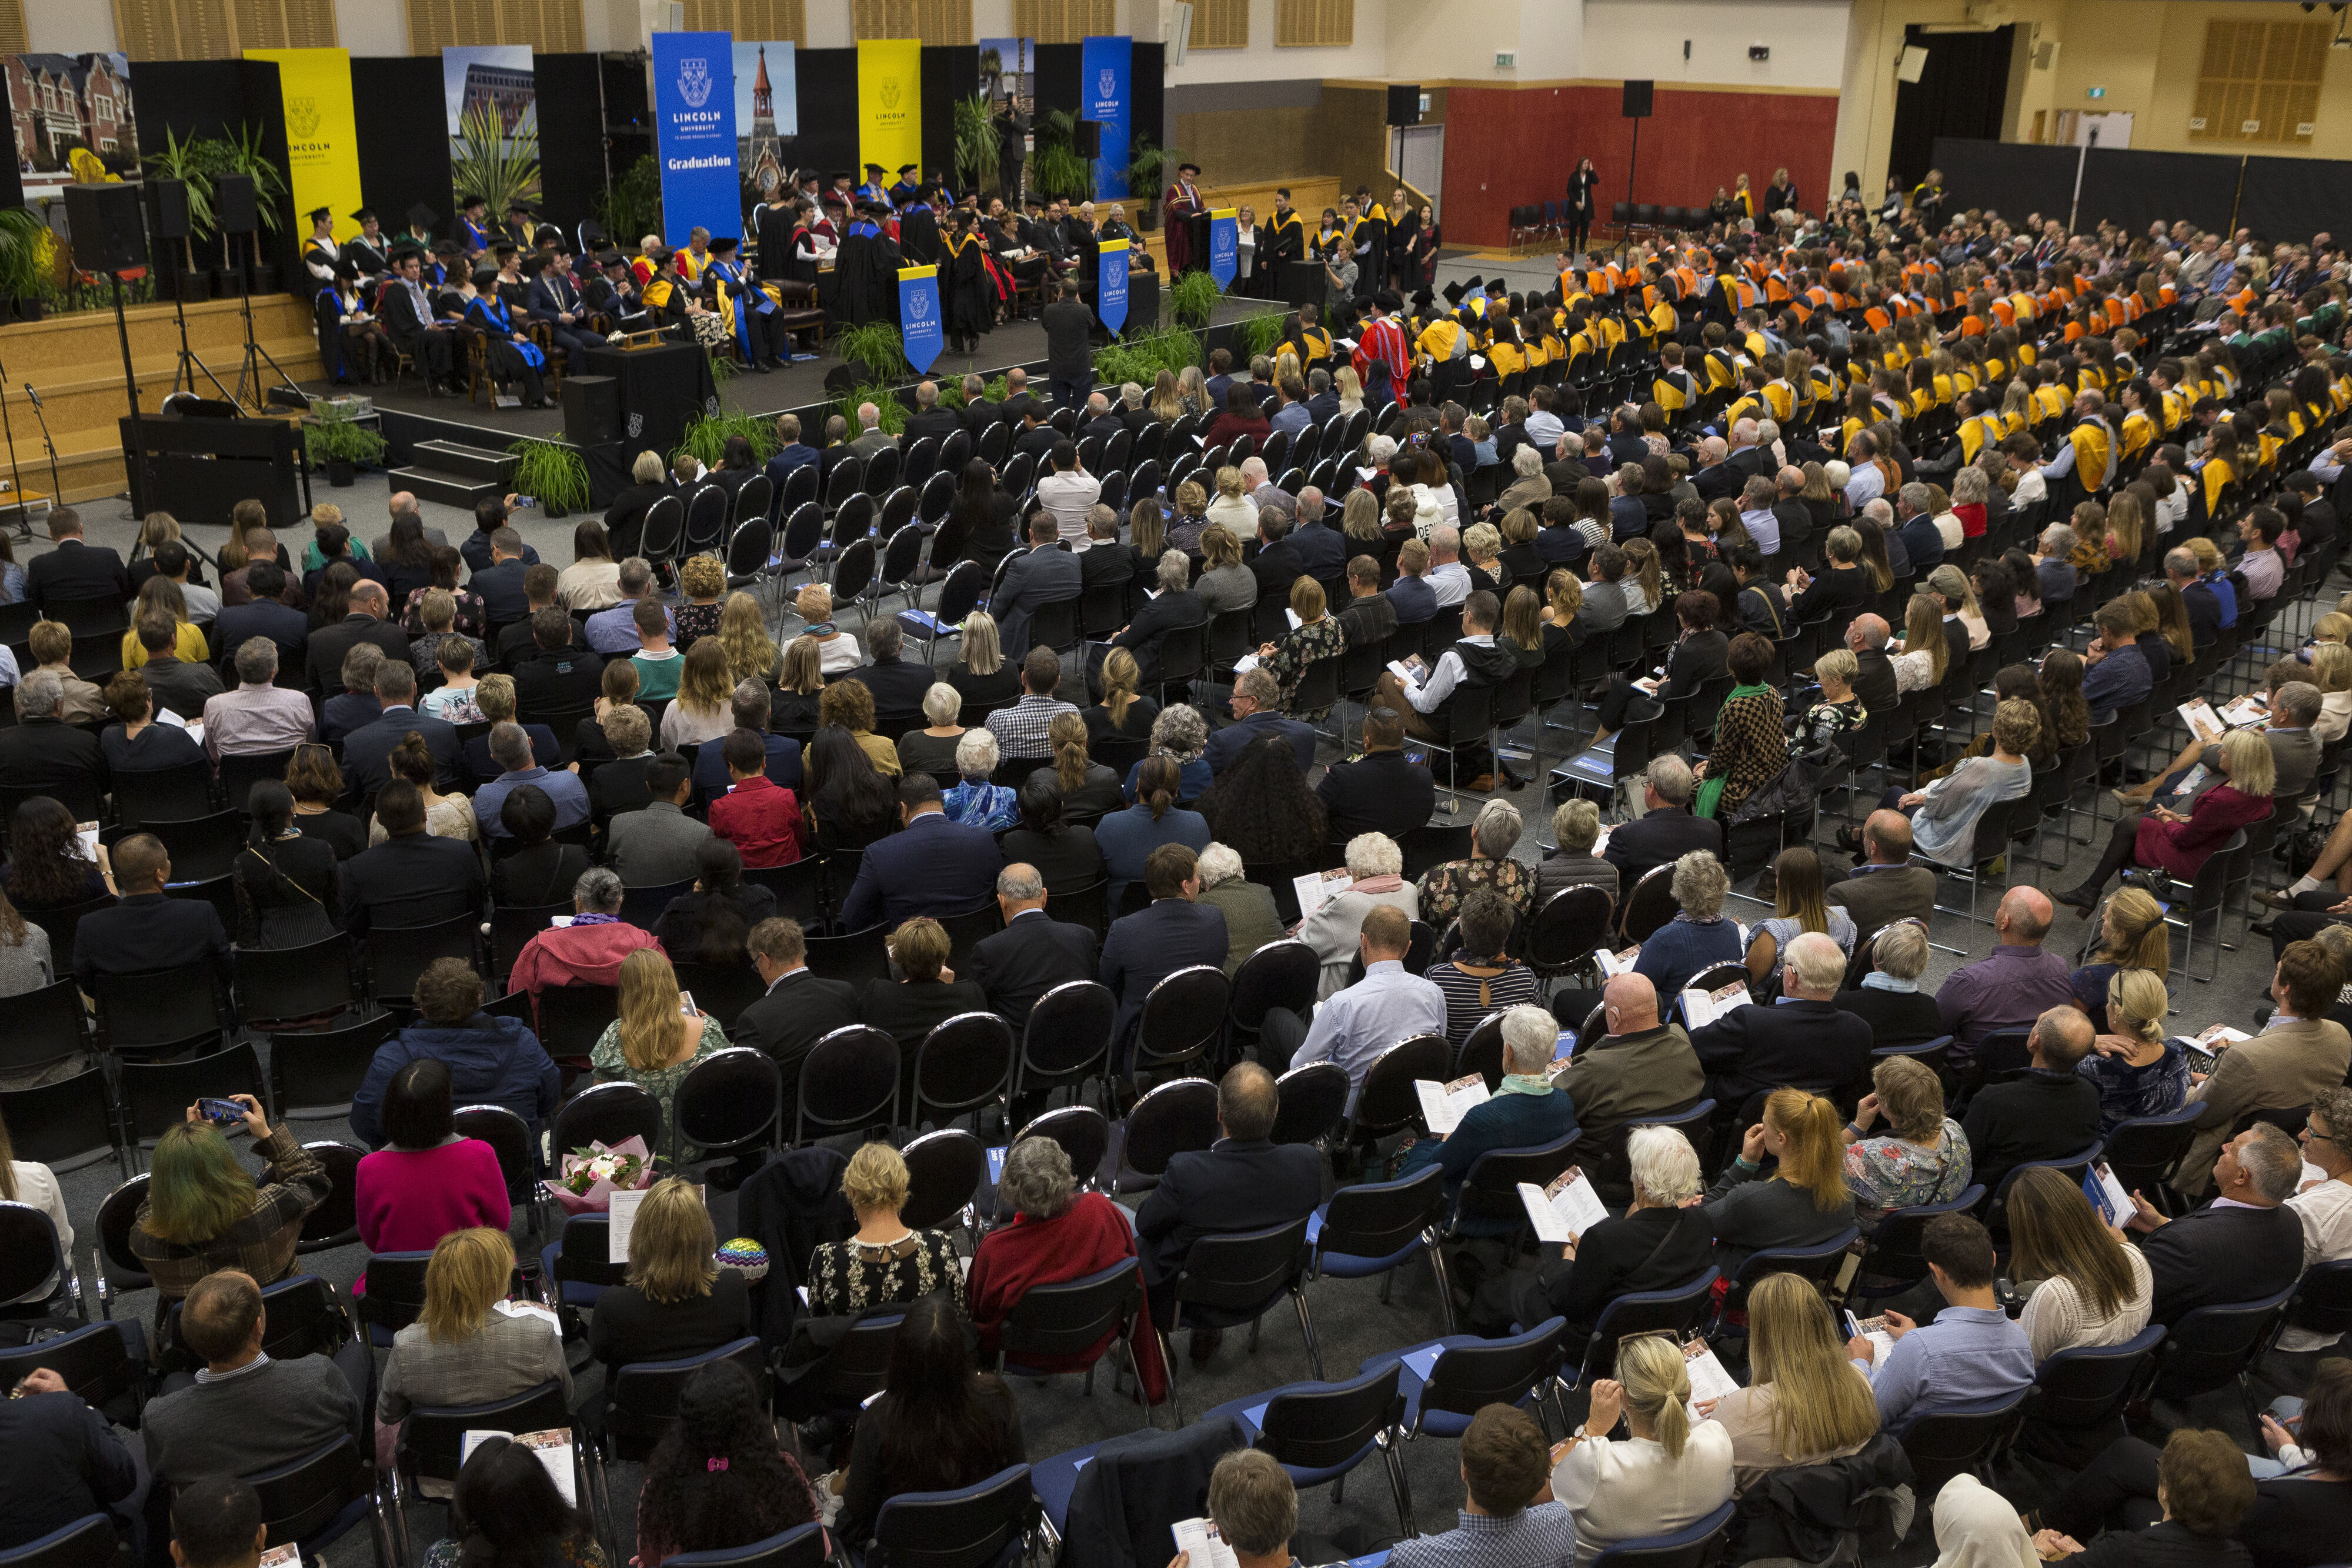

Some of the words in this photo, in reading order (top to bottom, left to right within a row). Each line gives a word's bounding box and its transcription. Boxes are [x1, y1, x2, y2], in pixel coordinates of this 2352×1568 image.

[673, 111, 720, 123] LINCOLN
[680, 124, 715, 132] UNIVERSITY
[288, 143, 330, 152] INCOLN
[668, 154, 731, 171] Graduation
[1104, 288, 1126, 297] LINCOLN
[906, 320, 936, 330] LINCOLN
